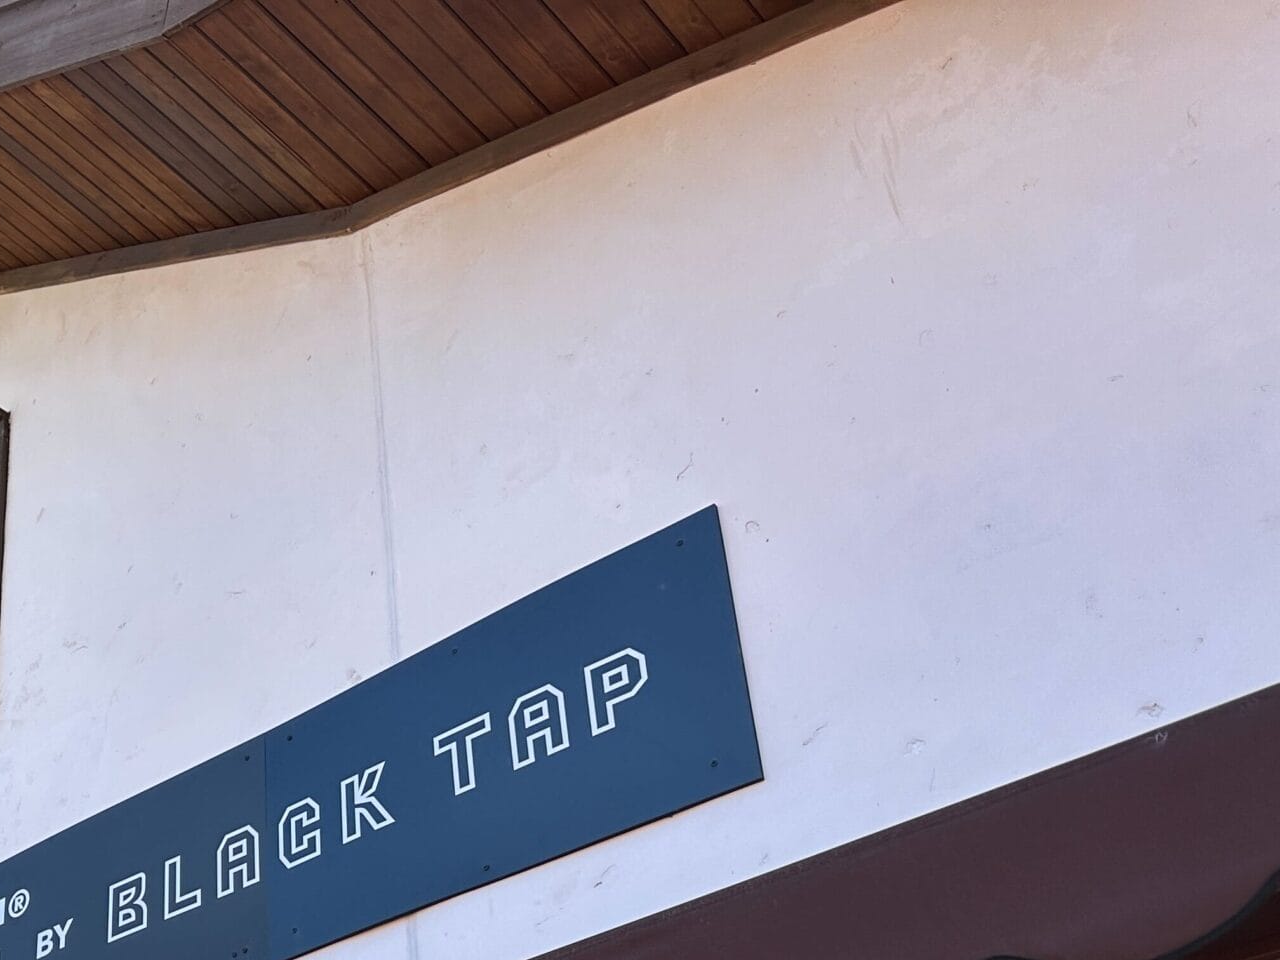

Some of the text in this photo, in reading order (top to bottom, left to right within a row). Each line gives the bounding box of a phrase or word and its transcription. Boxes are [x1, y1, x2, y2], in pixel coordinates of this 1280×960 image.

[35, 918, 74, 960] BY
[106, 760, 396, 944] BLACK
[432, 647, 648, 796] TAP
